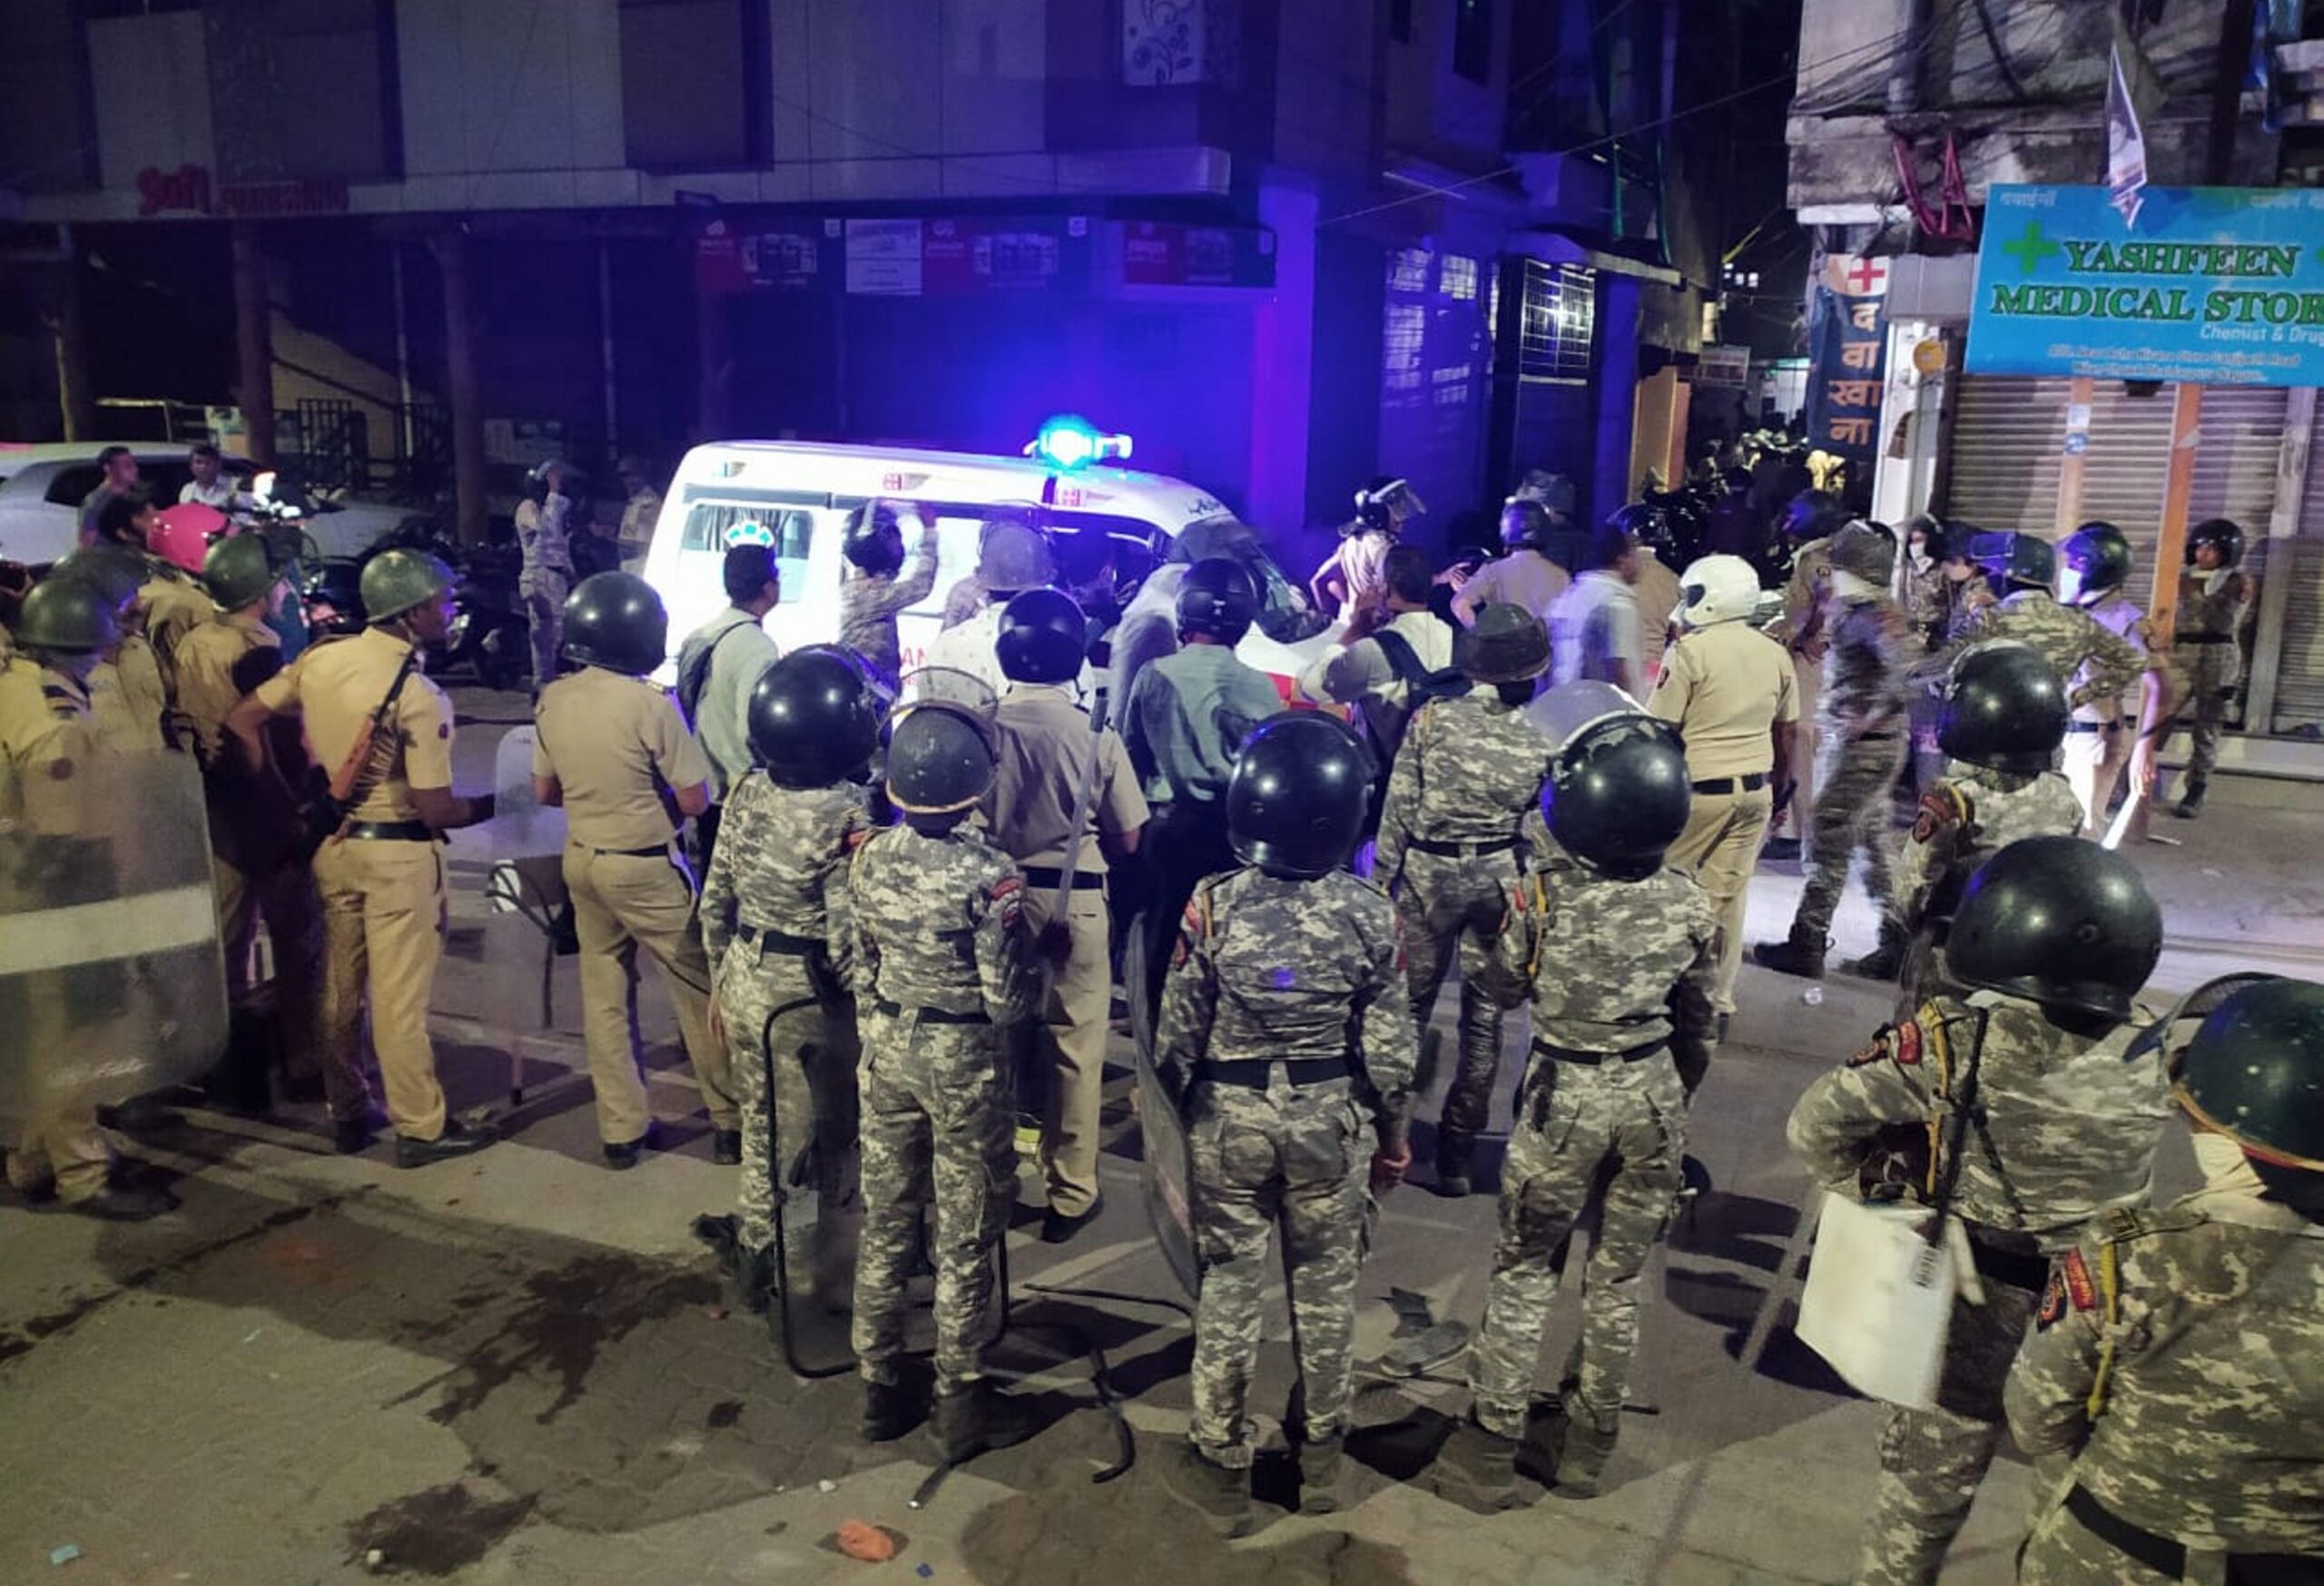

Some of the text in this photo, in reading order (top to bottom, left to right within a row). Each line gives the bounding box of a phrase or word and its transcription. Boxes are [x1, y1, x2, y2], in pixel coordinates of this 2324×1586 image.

[2063, 240, 2301, 278] YASHFEEN
[1990, 283, 2195, 321] MEDICAL
[2200, 324, 2267, 341] Chemist
[2271, 327, 2283, 342] &
